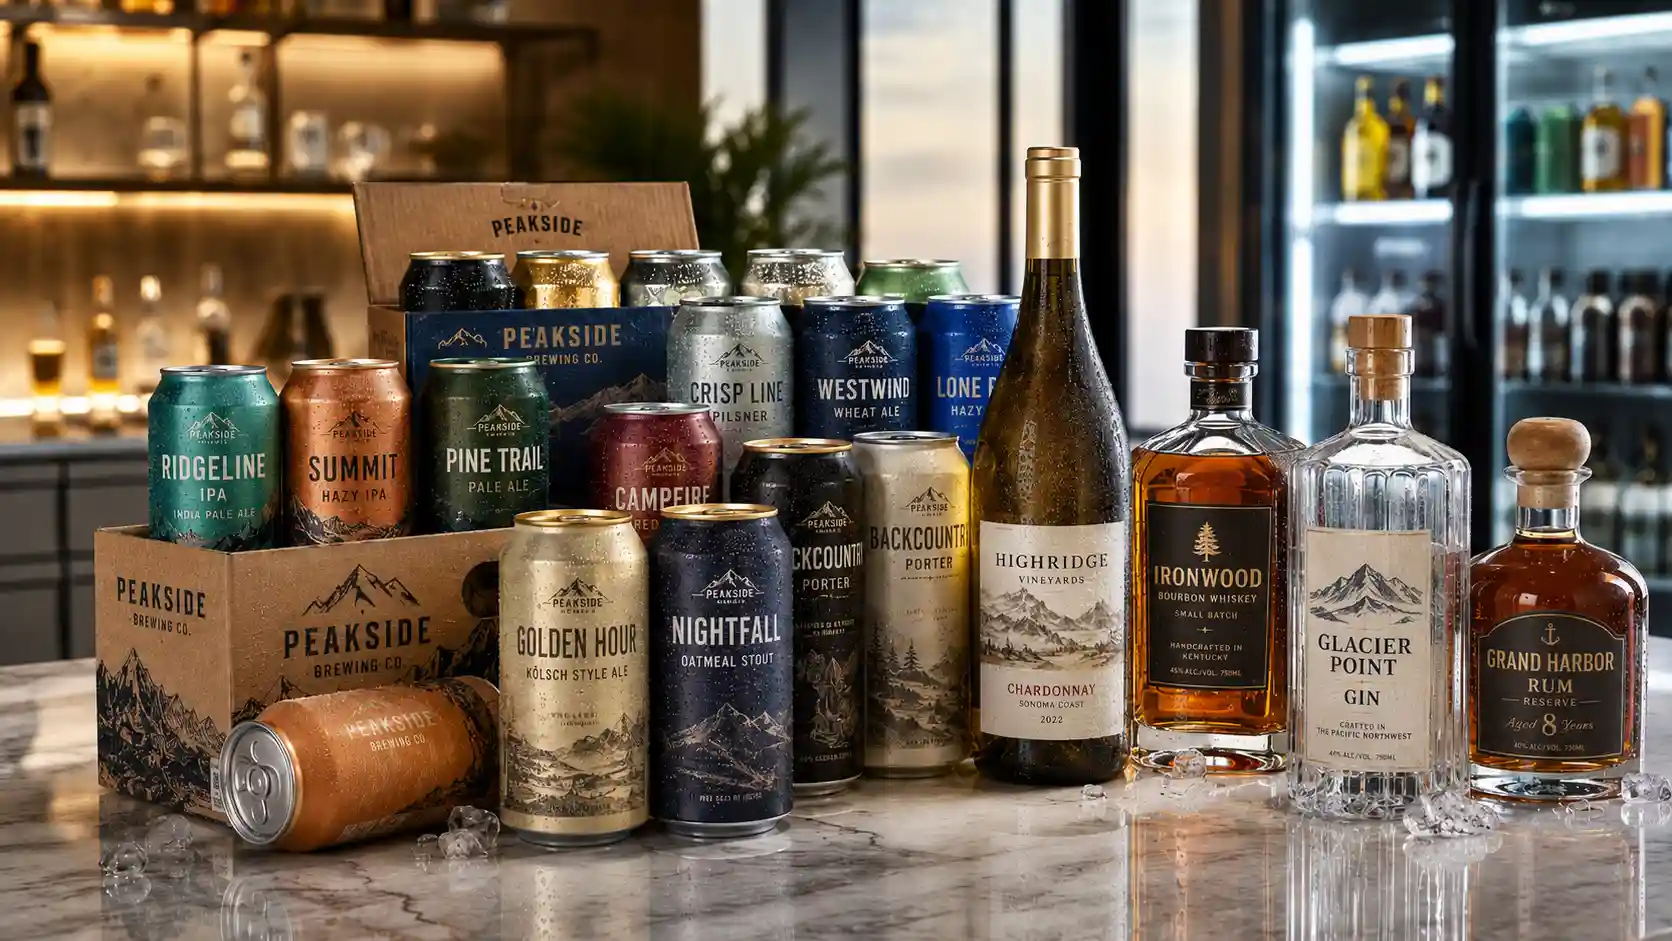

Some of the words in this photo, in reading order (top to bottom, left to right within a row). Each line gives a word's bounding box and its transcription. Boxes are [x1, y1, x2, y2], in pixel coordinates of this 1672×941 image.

[491, 215, 584, 238] PEAKSIDE
[503, 324, 622, 349] PEAKSIDE
[584, 353, 603, 364] CO.
[720, 359, 760, 368] PEAKSIDE
[848, 356, 889, 365] PEAKSIDE
[690, 382, 743, 404] CRISP
[751, 381, 783, 404] LINE
[817, 377, 910, 400] WESTWIND
[937, 376, 982, 398] LONE
[713, 410, 768, 422] PILSNER
[834, 407, 876, 419] WHEAT
[881, 405, 900, 418] ALE
[951, 405, 982, 416] HAZY
[190, 430, 236, 439] PEAKSIDE
[478, 422, 521, 432] PEAKSIDE
[446, 447, 492, 473] PINE
[498, 444, 544, 473] TRAIL
[161, 453, 266, 481] RIDGELINE
[308, 453, 398, 482] SUMMIT
[468, 481, 502, 493] PALE
[507, 480, 529, 492] ALE
[200, 488, 228, 502] IPA
[322, 490, 358, 503] HAZY
[366, 489, 387, 501] IPA
[173, 509, 200, 520] INDIA
[205, 509, 233, 519] PALE
[238, 508, 256, 518] ALE
[911, 503, 948, 512] PEAKSIDE
[634, 519, 659, 530] RED
[808, 518, 847, 529] PEAKSIDE
[792, 541, 863, 571] CKCOUNTR
[905, 556, 953, 571] PORTER
[995, 553, 1108, 569] HIGHRIDGE
[803, 576, 850, 591] PORTER
[1019, 575, 1085, 585] VINEYARDS
[1154, 565, 1262, 588] IRONWOOD
[117, 576, 206, 618] PEAKSIDE
[706, 588, 754, 599] PEAKSIDE
[1158, 591, 1205, 603] BOURBON
[1209, 594, 1257, 604] WHISKEY
[552, 597, 603, 608] PEAKSIDE
[1174, 609, 1204, 619] SMALL
[1207, 611, 1238, 620] BATCH
[133, 613, 173, 632] BREWING
[176, 622, 191, 636] CO.
[672, 613, 780, 646] NIGHTFALL
[283, 616, 431, 659] PEAKSIDE
[517, 625, 586, 659] GOLDEN
[595, 623, 637, 657] HOUR
[1318, 633, 1412, 654] GLACIER
[1170, 642, 1231, 651] HANDCRAFTED
[681, 654, 736, 668] OATMEAL
[741, 652, 774, 666] STOUT
[1182, 653, 1229, 661] KENTUCKY
[1487, 649, 1541, 672] GRAND
[1547, 652, 1614, 672] HARBOR
[314, 659, 378, 678] BREWING
[1330, 656, 1397, 675] POINT
[572, 668, 607, 682] STYLE
[611, 665, 628, 679] ALE
[1007, 682, 1096, 697] CHARDONNAY
[1528, 678, 1573, 694] RUM
[1019, 700, 1055, 708] SONOMA
[1058, 700, 1085, 708] COAST
[1344, 689, 1380, 706] GIN
[1523, 697, 1577, 707] RESERVE
[344, 710, 437, 740] PEAKSIDE
[1040, 716, 1063, 724] 2022
[1340, 721, 1374, 730] CRAFTED
[1505, 717, 1538, 732] Aged
[1542, 713, 1557, 736] 8
[1561, 719, 1594, 732] Years
[1316, 727, 1329, 736] THE
[1331, 729, 1360, 738] PACIFIC
[1363, 732, 1412, 740] NORTHWEST
[370, 735, 412, 751] BREWING
